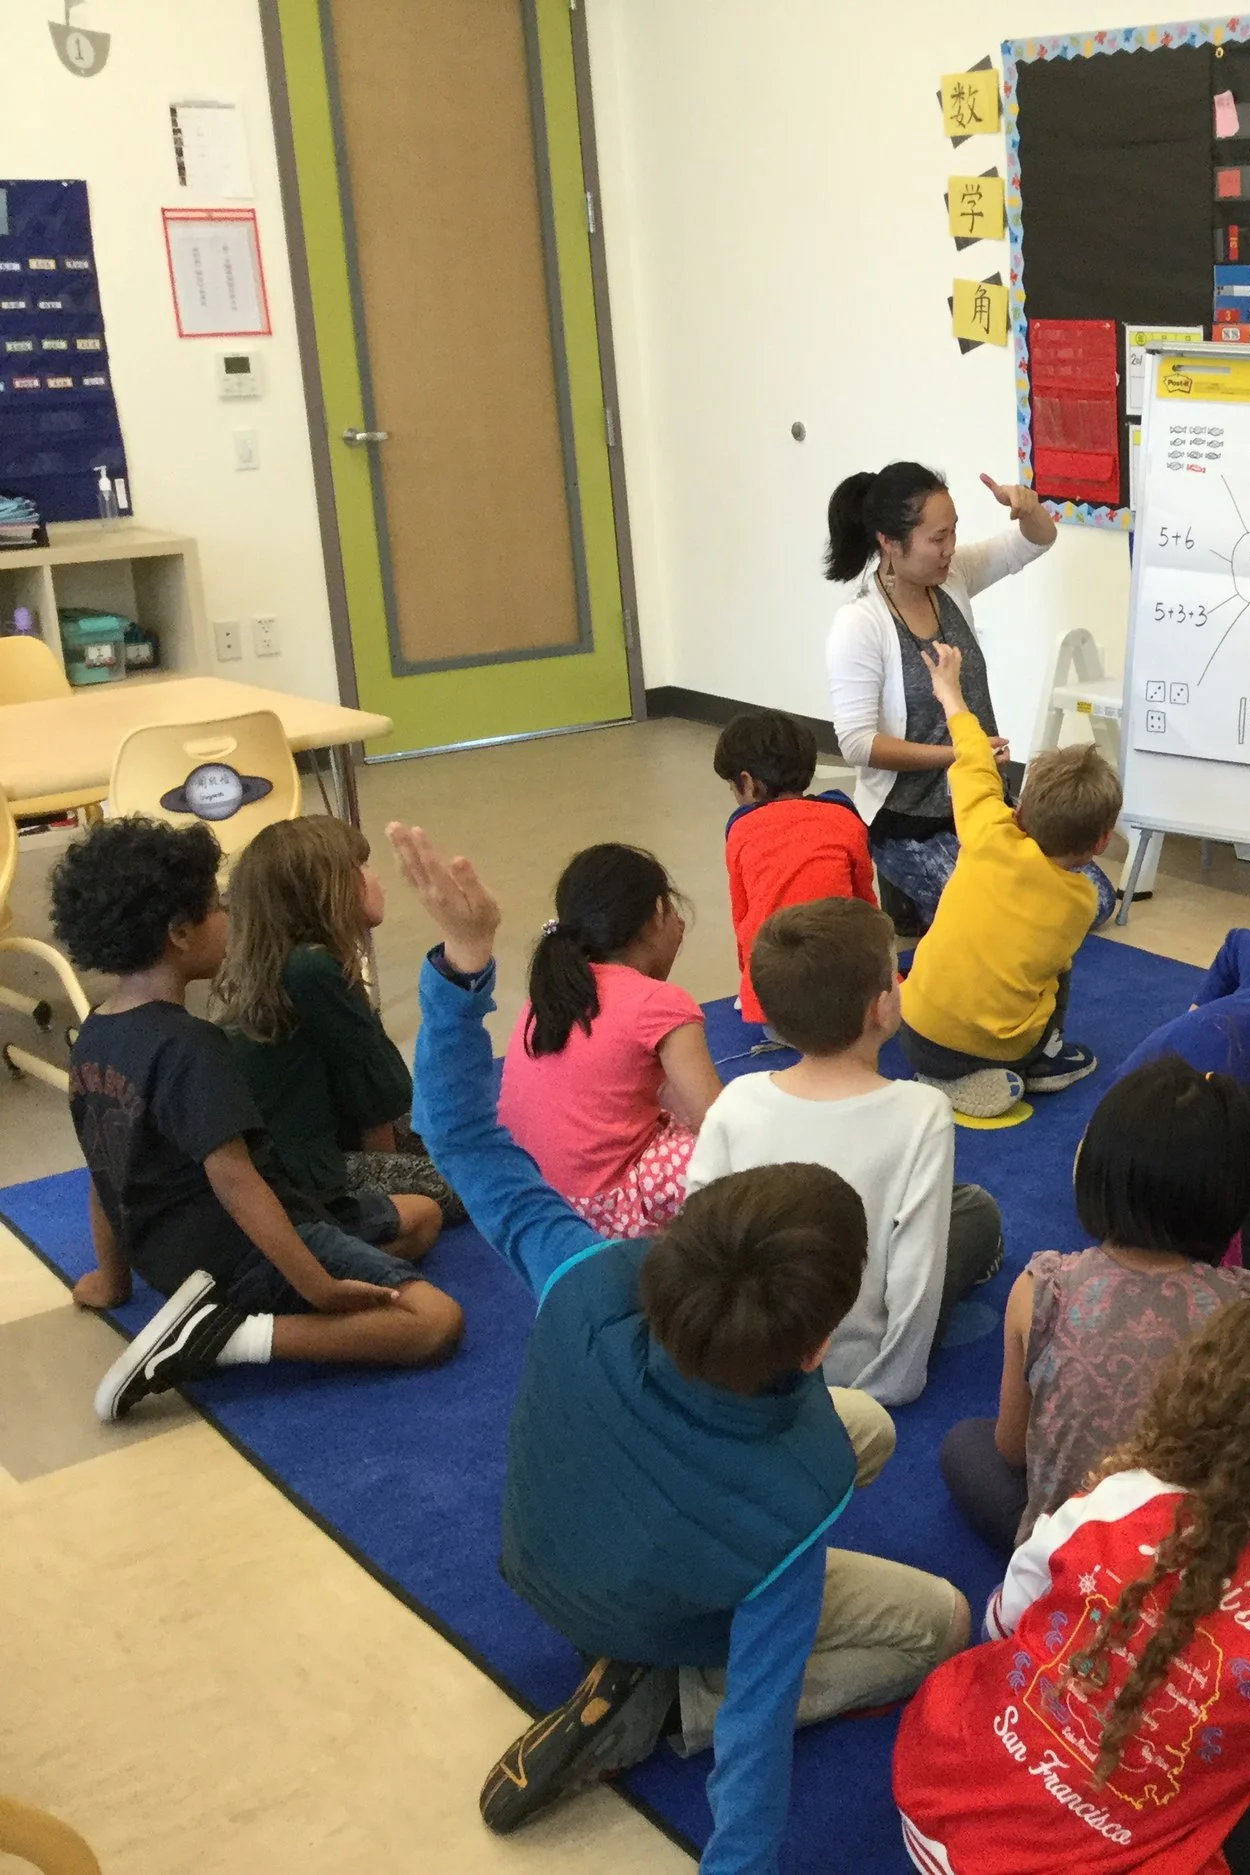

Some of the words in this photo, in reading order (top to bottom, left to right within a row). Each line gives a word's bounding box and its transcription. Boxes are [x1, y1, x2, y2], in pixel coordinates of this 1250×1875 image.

[950, 84, 983, 130] 数
[960, 184, 985, 235] 学
[970, 286, 992, 332] 角
[1154, 603, 1209, 627] 5+3+3
[994, 1705, 1026, 1763] San
[1028, 1748, 1133, 1846] Francisco
